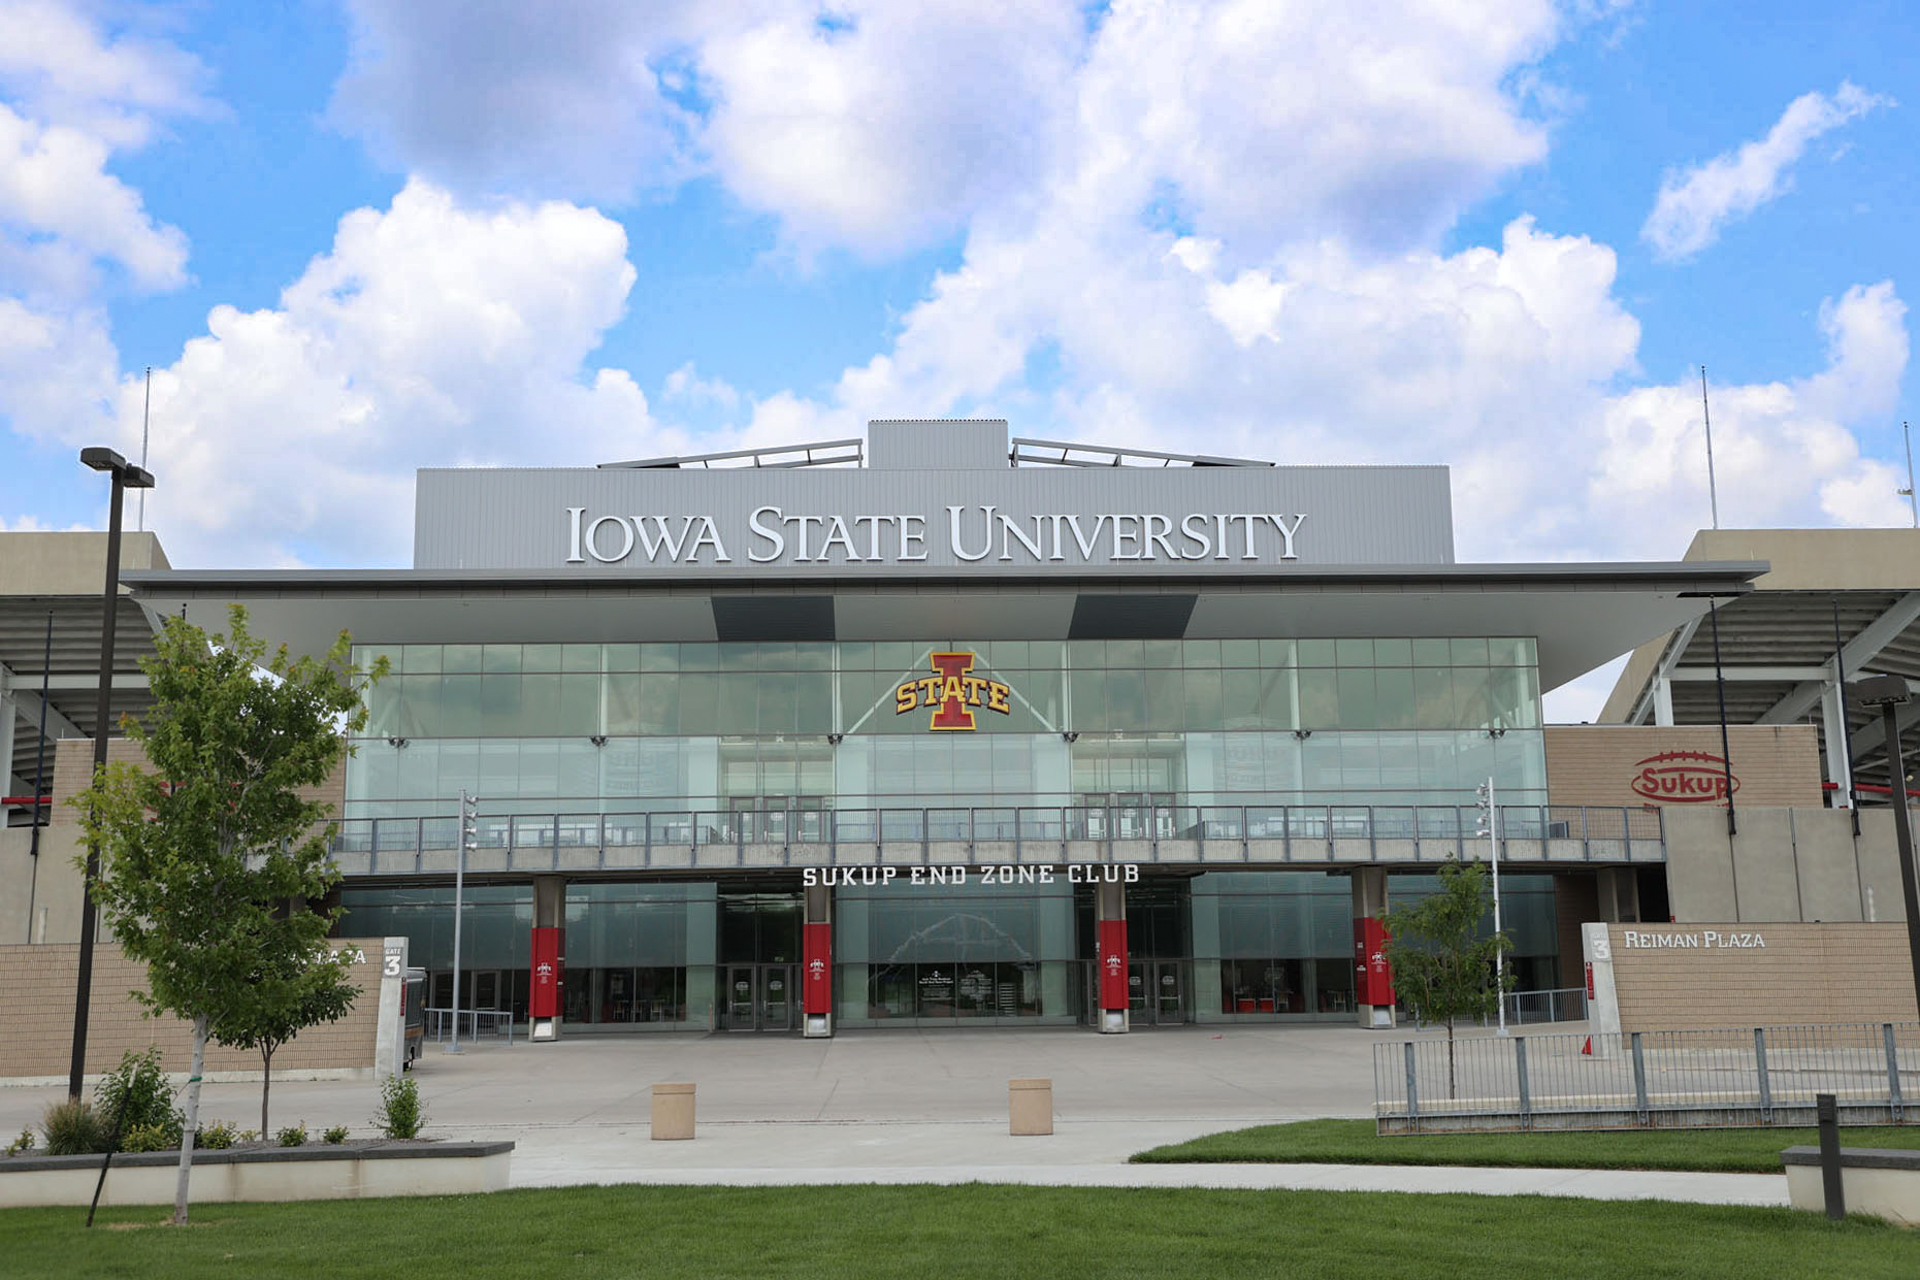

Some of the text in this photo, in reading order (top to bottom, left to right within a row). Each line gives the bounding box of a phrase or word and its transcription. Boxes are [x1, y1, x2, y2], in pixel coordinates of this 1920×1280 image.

[566, 505, 1308, 563] IOWA STATE UNIVERSITY
[896, 676, 1010, 715] STATE
[803, 864, 1140, 887] SUKUP END ZONE CLUB
[1593, 940, 1609, 959] 3
[1624, 931, 1766, 948] REIMAN PLAZA
[384, 955, 401, 976] 3
